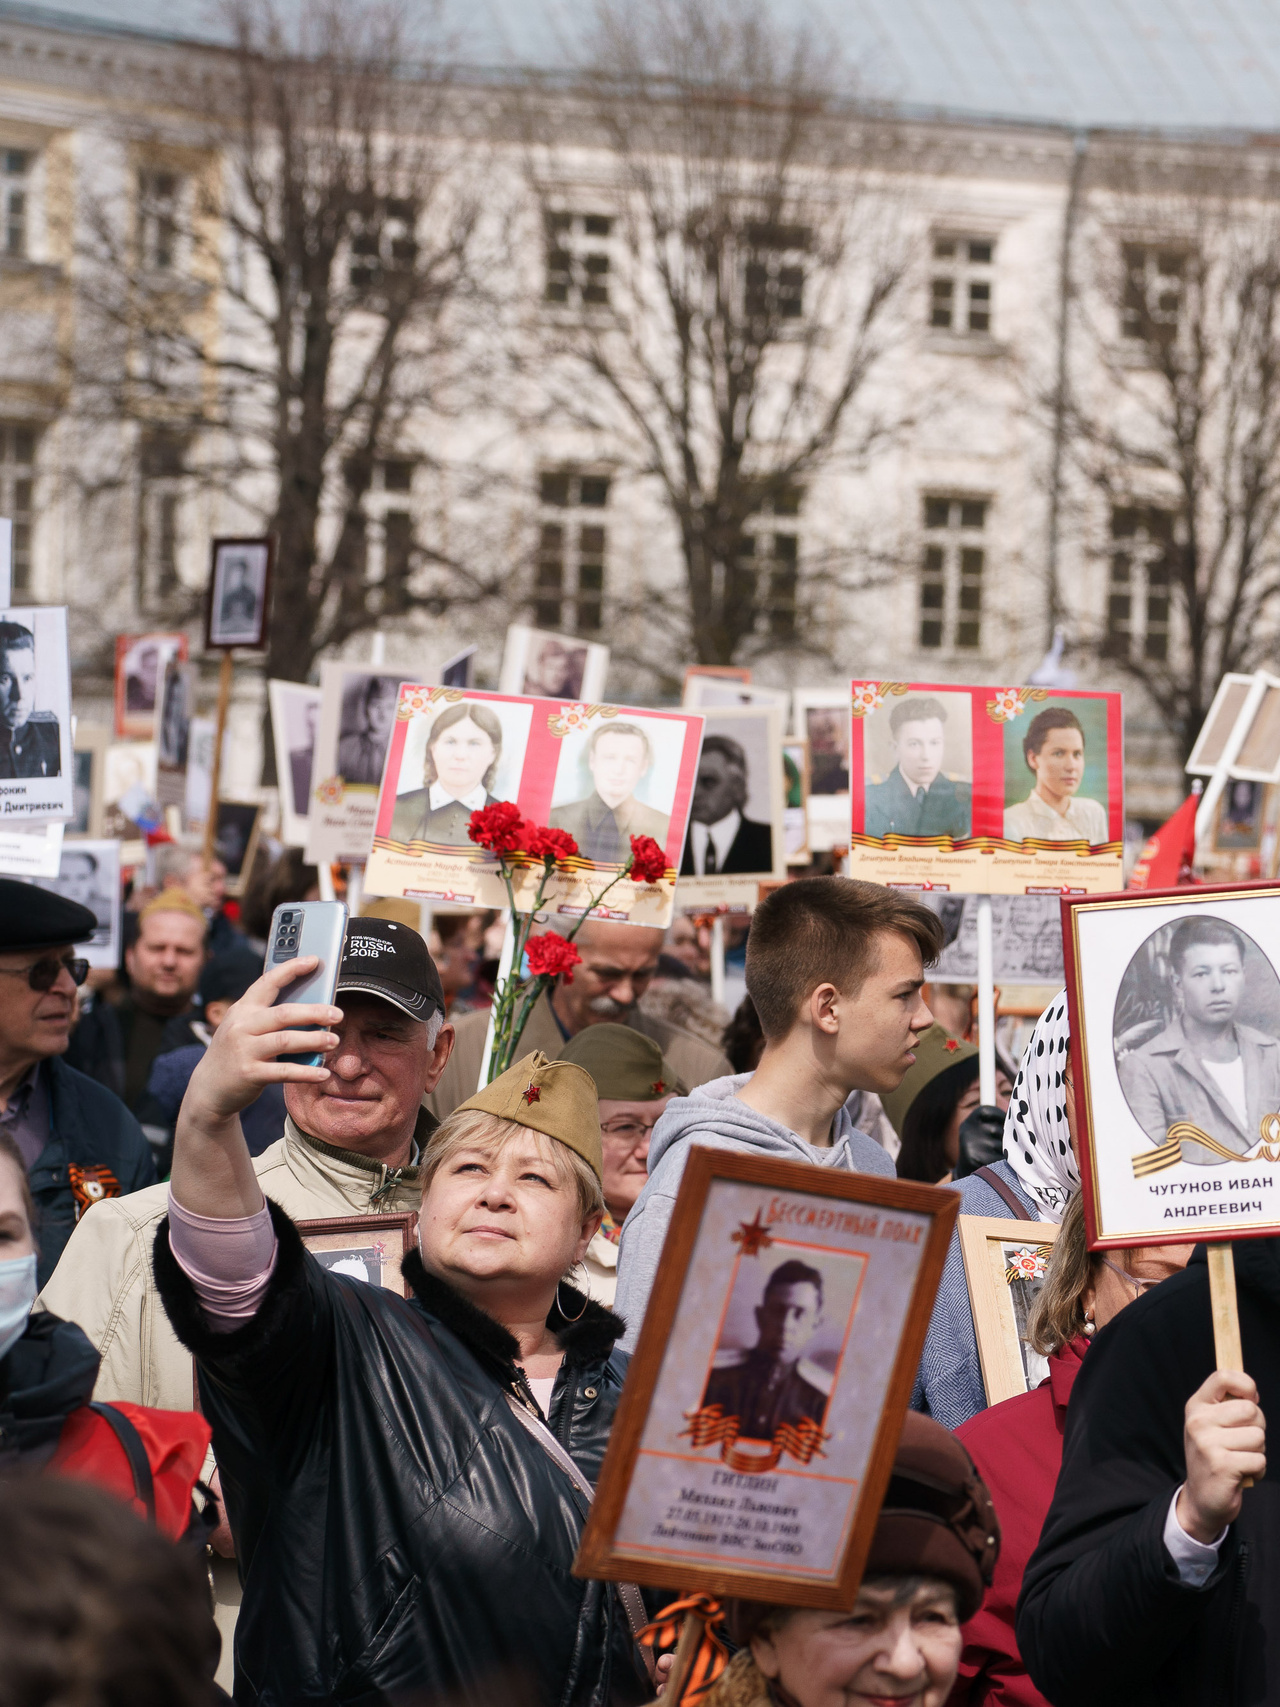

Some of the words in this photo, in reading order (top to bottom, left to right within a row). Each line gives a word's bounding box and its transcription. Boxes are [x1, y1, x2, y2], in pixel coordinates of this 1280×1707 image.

[5, 801, 64, 814] Дмитриевич
[350, 940, 397, 954] RUSSIA
[350, 948, 379, 958] 2018
[1150, 1180, 1223, 1196] ЧУГУНОВ
[1229, 1177, 1274, 1191] ИВАН
[1163, 1201, 1263, 1218] АНДРЕЕВИЧ
